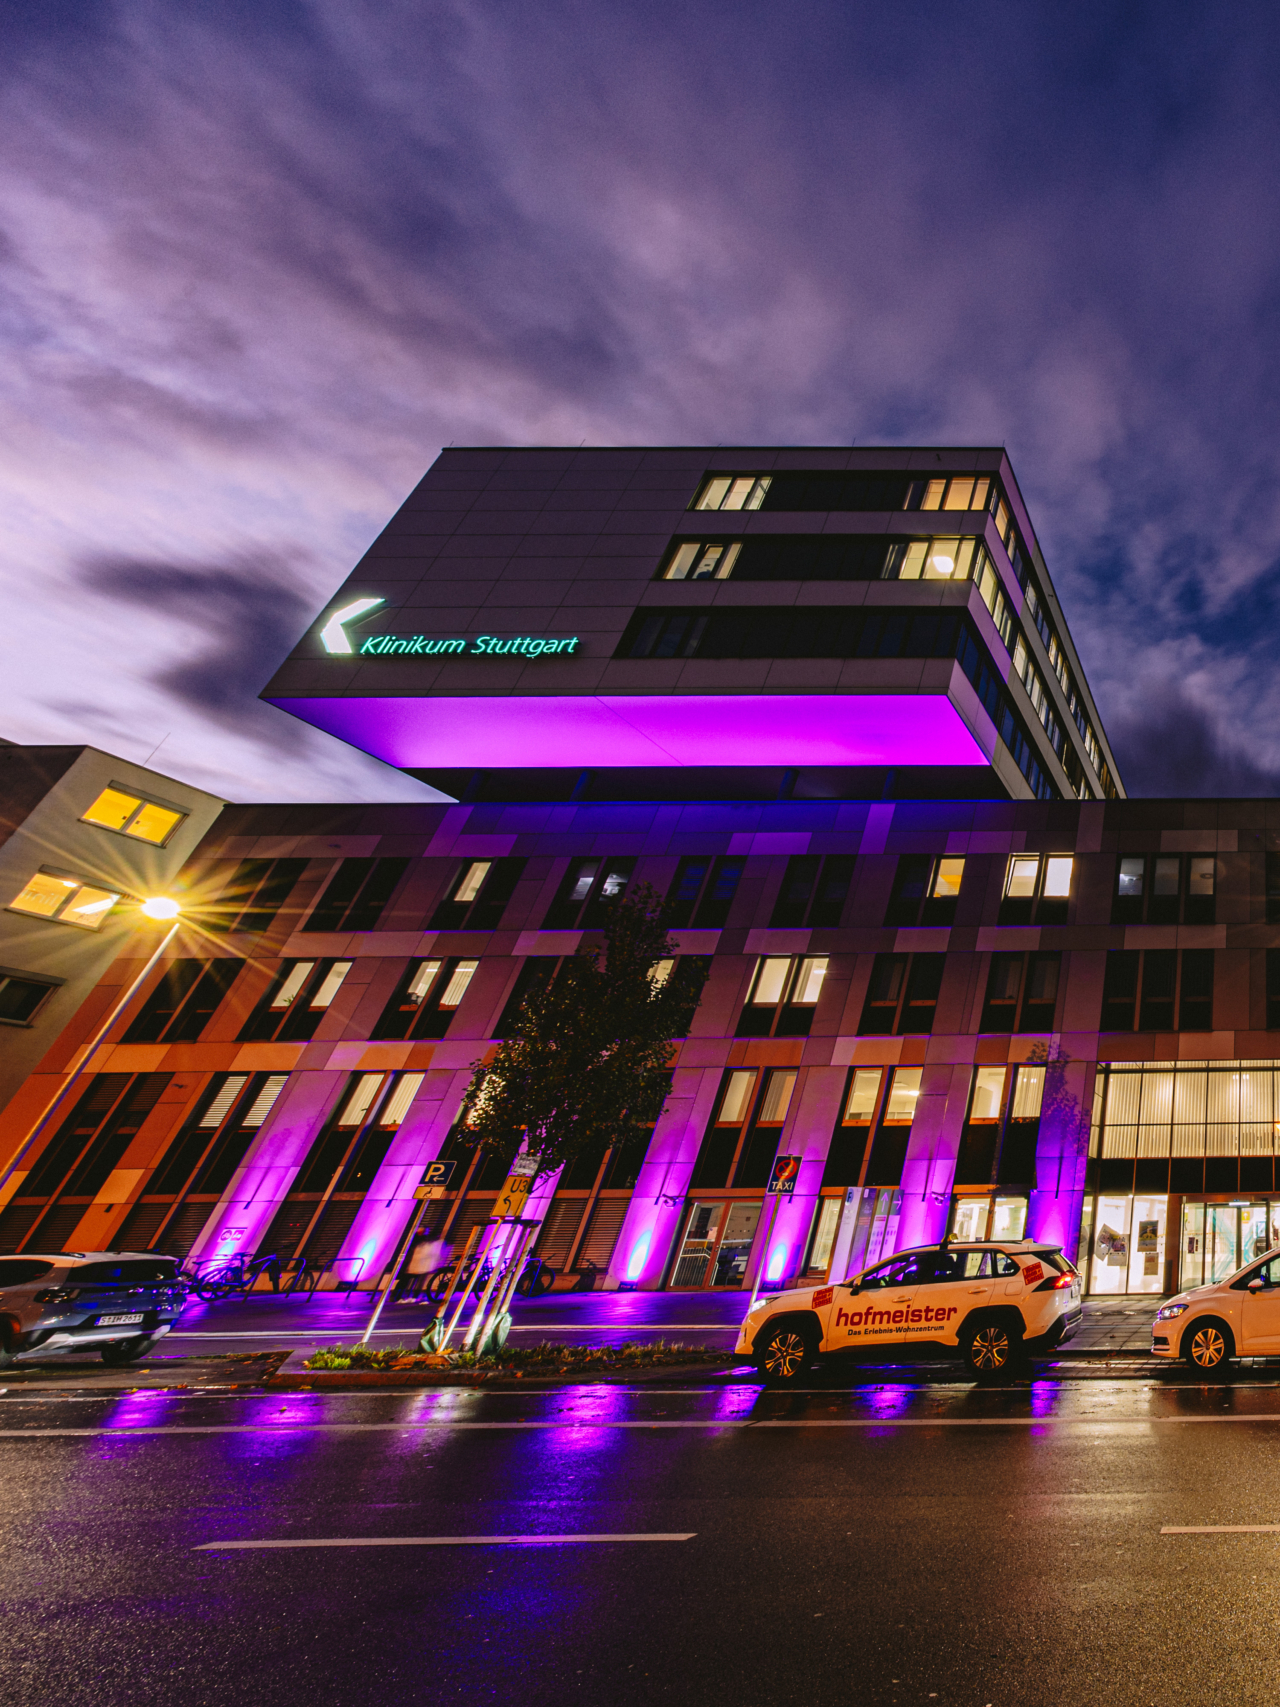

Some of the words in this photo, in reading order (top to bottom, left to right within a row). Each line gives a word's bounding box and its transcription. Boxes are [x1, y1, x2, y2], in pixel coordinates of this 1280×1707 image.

[359, 635, 466, 655] Klinikum
[470, 635, 580, 659] Stuttgart
[425, 1164, 445, 1182] P
[511, 1179, 528, 1193] U3
[771, 1181, 794, 1191] TAXI
[835, 1304, 957, 1326] hofmeister
[847, 1328, 862, 1336] Das
[863, 1325, 945, 1335] Erlebnis-Wohnzentrum
